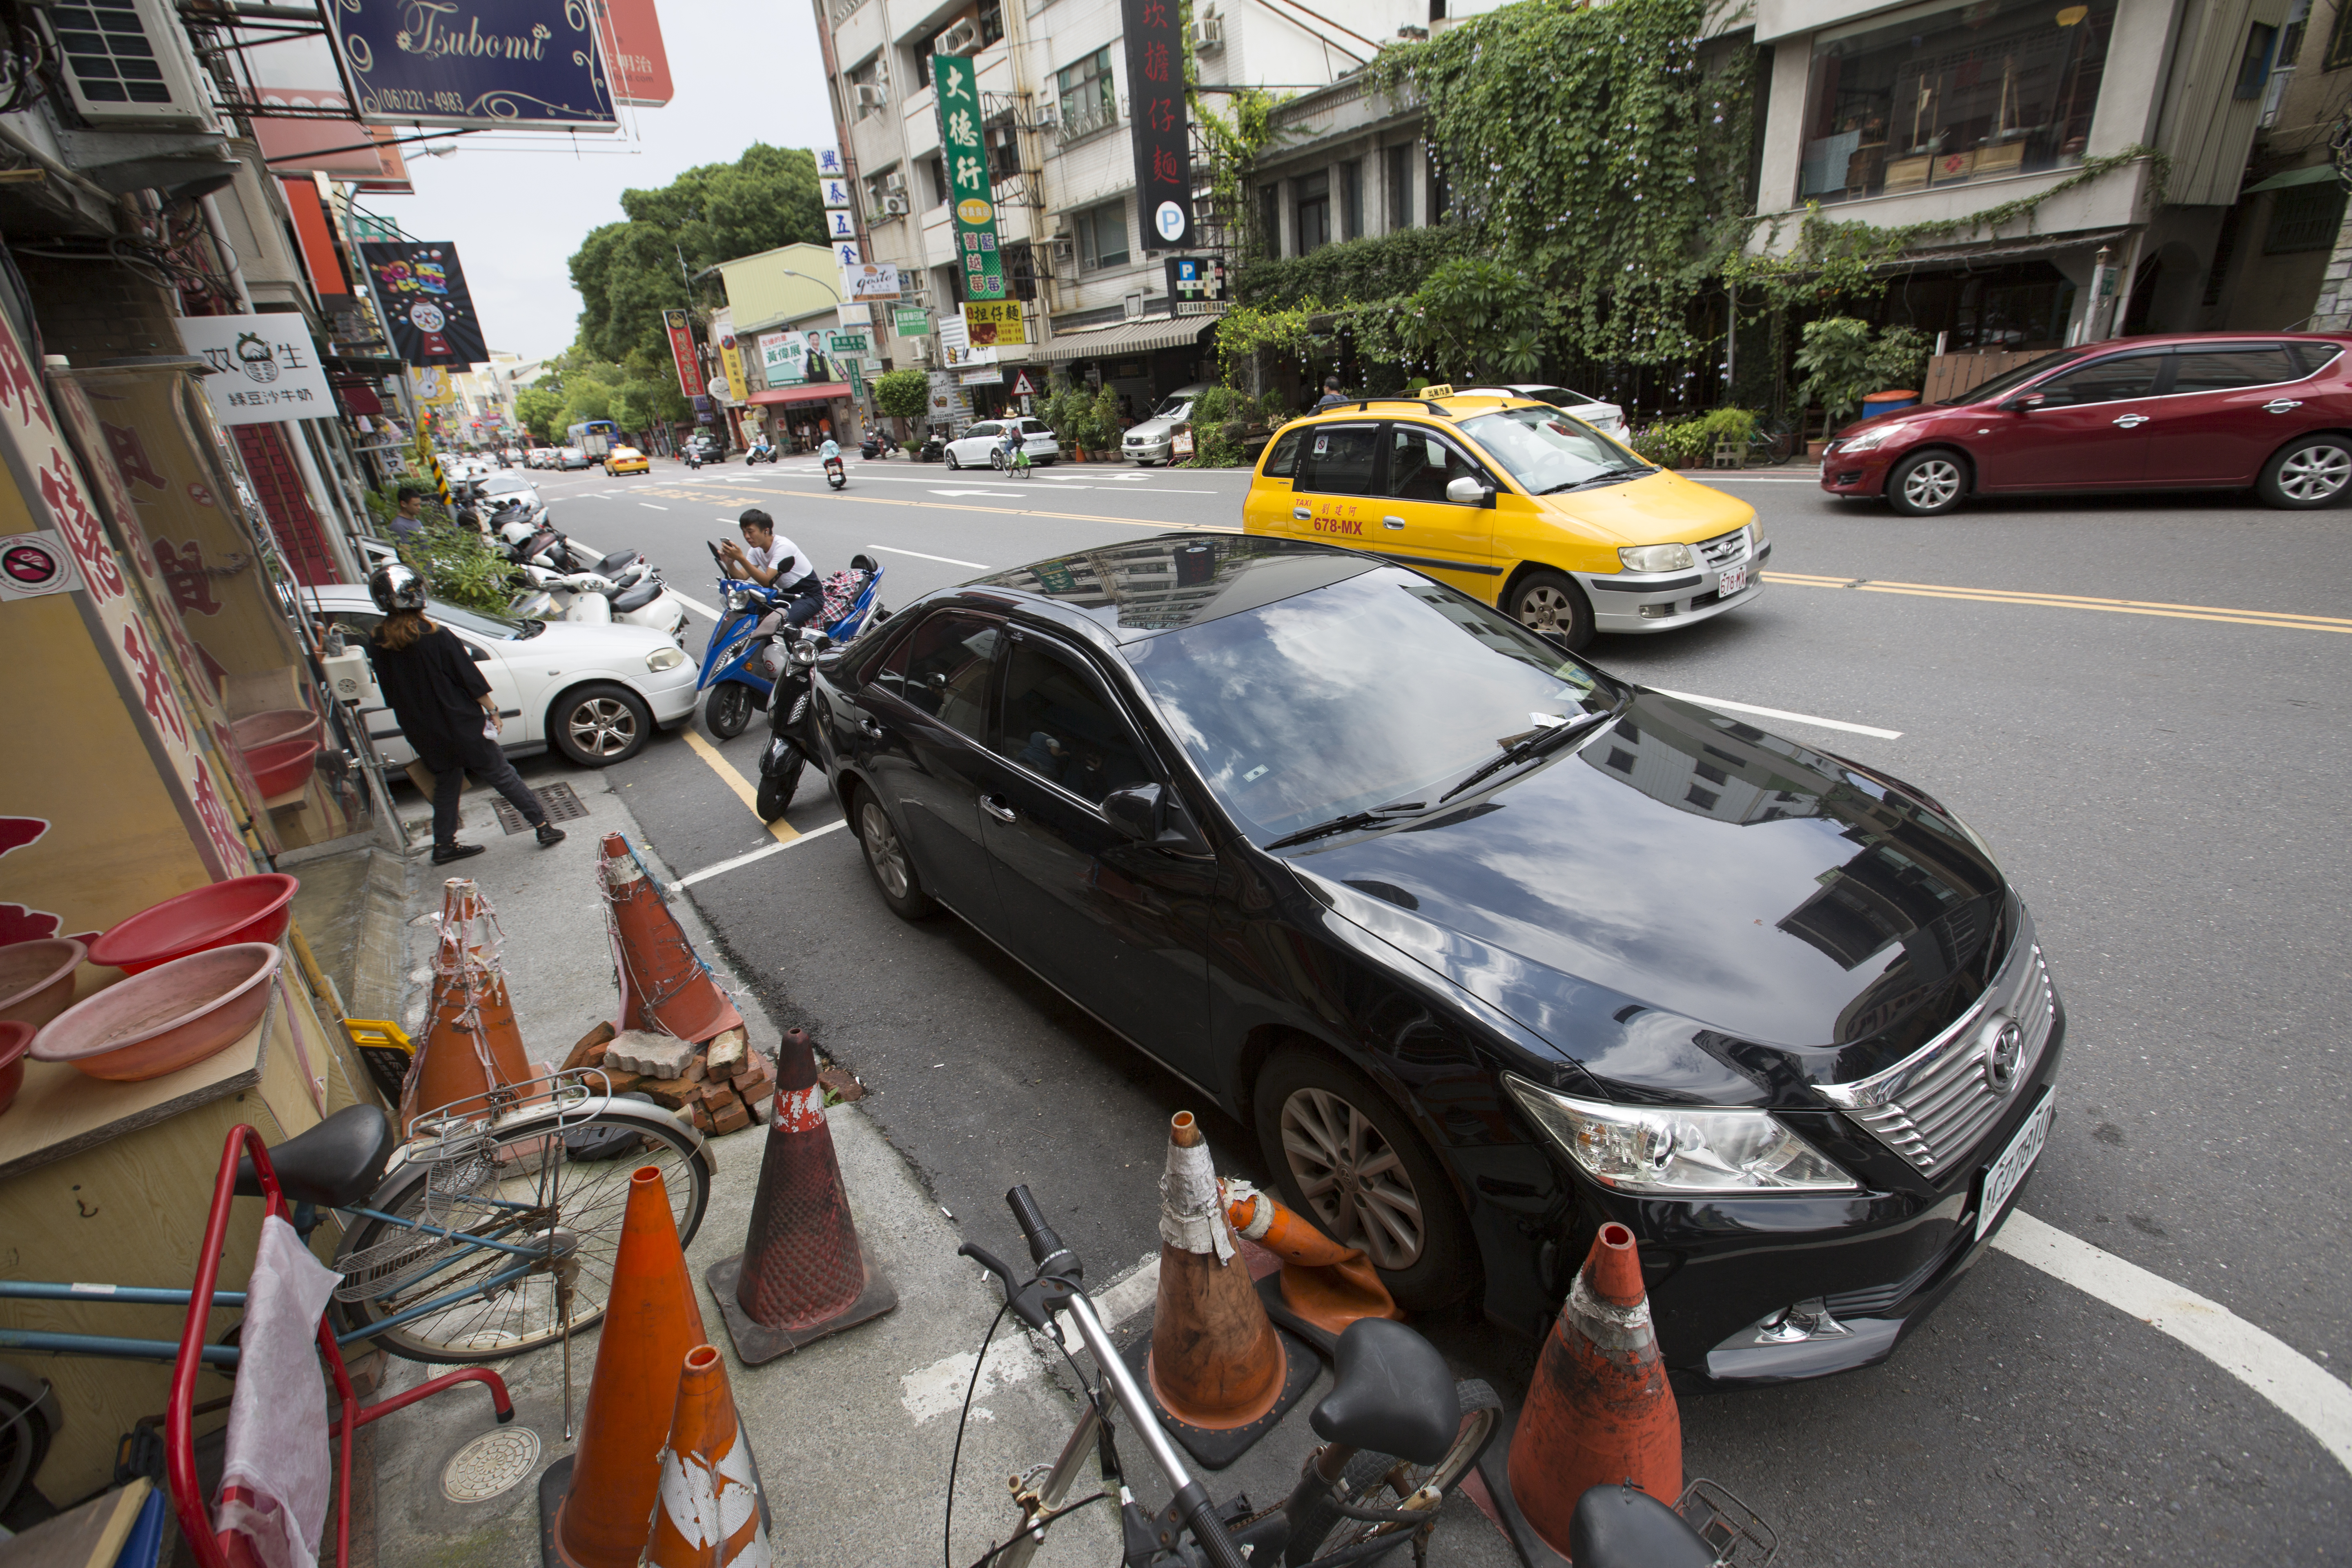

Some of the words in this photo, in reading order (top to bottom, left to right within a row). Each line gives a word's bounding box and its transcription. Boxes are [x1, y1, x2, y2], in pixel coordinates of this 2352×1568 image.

[396, 0, 547, 61] Tsubomi
[609, 73, 653, 82] food.com
[378, 87, 464, 113] (06)221-4983
[946, 65, 982, 190] 大德行
[821, 149, 857, 264] 興泰五金
[227, 389, 314, 407] 綠豆沙牛奶
[1428, 385, 1450, 398] 出租汽車
[1295, 499, 1312, 507] TAXI
[1321, 503, 1357, 517] 劉建何
[1314, 517, 1363, 535] 678-MX
[1720, 570, 1745, 594] 678-MX
